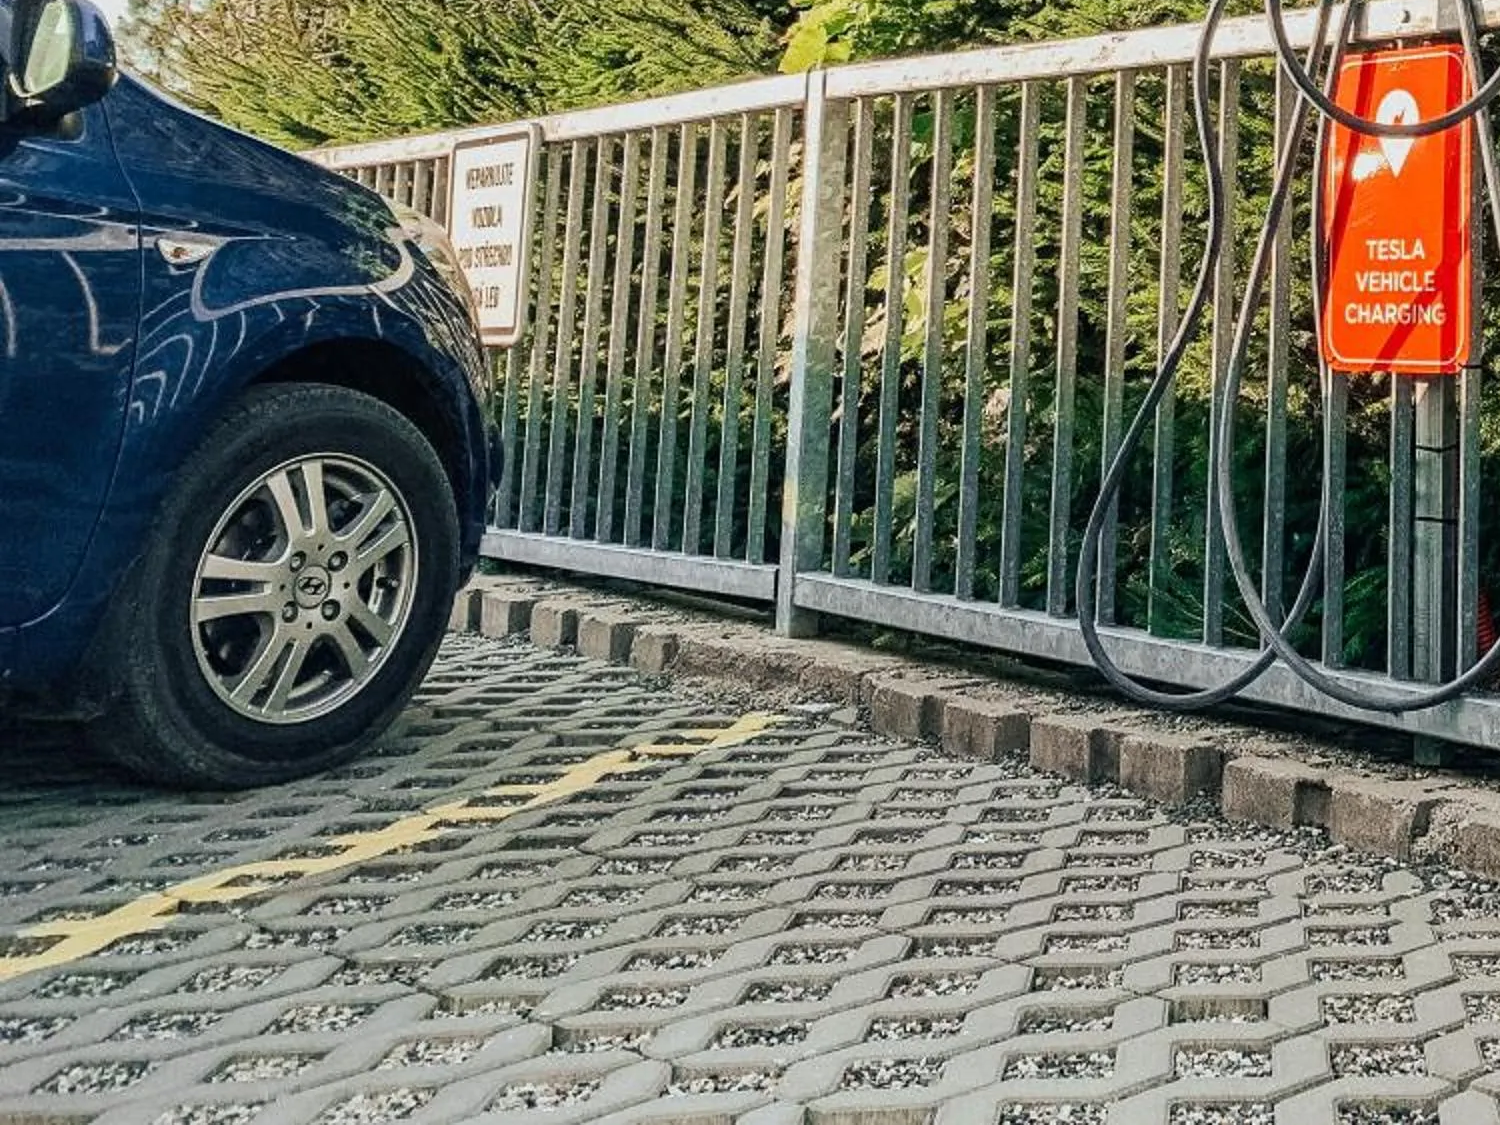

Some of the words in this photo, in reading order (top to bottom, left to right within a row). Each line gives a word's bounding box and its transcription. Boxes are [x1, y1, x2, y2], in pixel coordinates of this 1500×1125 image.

[1366, 239, 1425, 260] TESLA
[1355, 271, 1436, 292] VEHICLE
[1345, 303, 1446, 325] CHARGING
